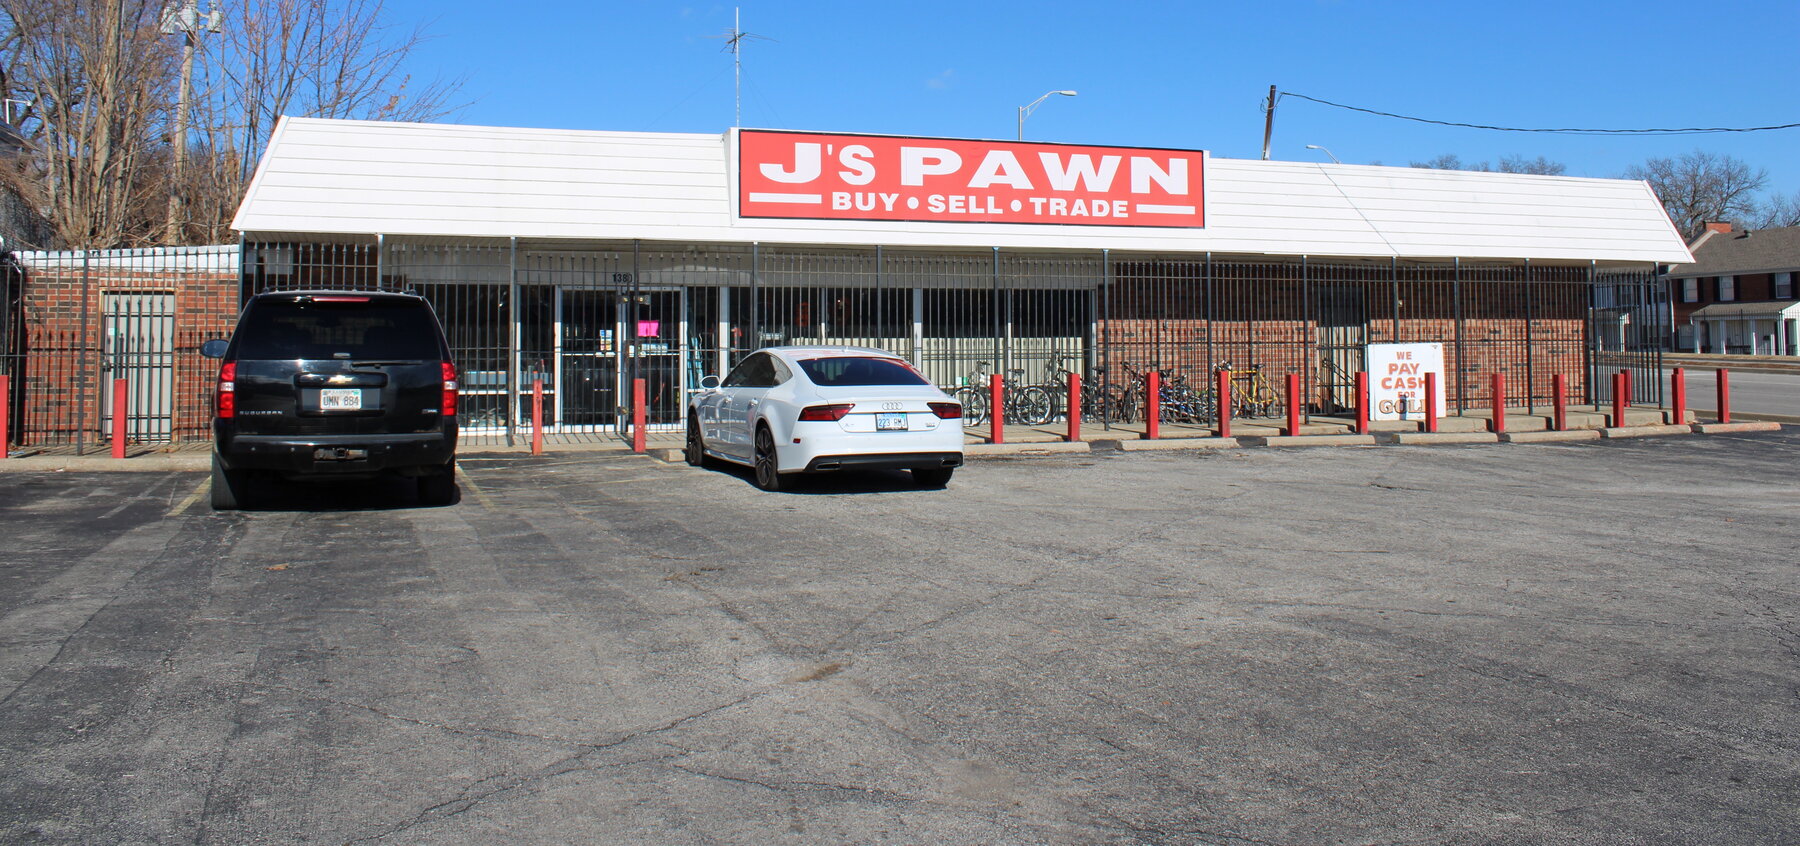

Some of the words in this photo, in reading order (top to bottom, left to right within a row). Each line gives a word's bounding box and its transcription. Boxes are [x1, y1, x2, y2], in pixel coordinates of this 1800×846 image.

[759, 142, 876, 186] J'S
[901, 146, 1189, 195] PAWN
[832, 191, 899, 211] BUY
[928, 195, 1003, 214] SELL
[1029, 197, 1129, 218] TRADE
[1396, 351, 1412, 360] WE
[1388, 363, 1420, 375] PAY
[343, 396, 359, 406] 884
